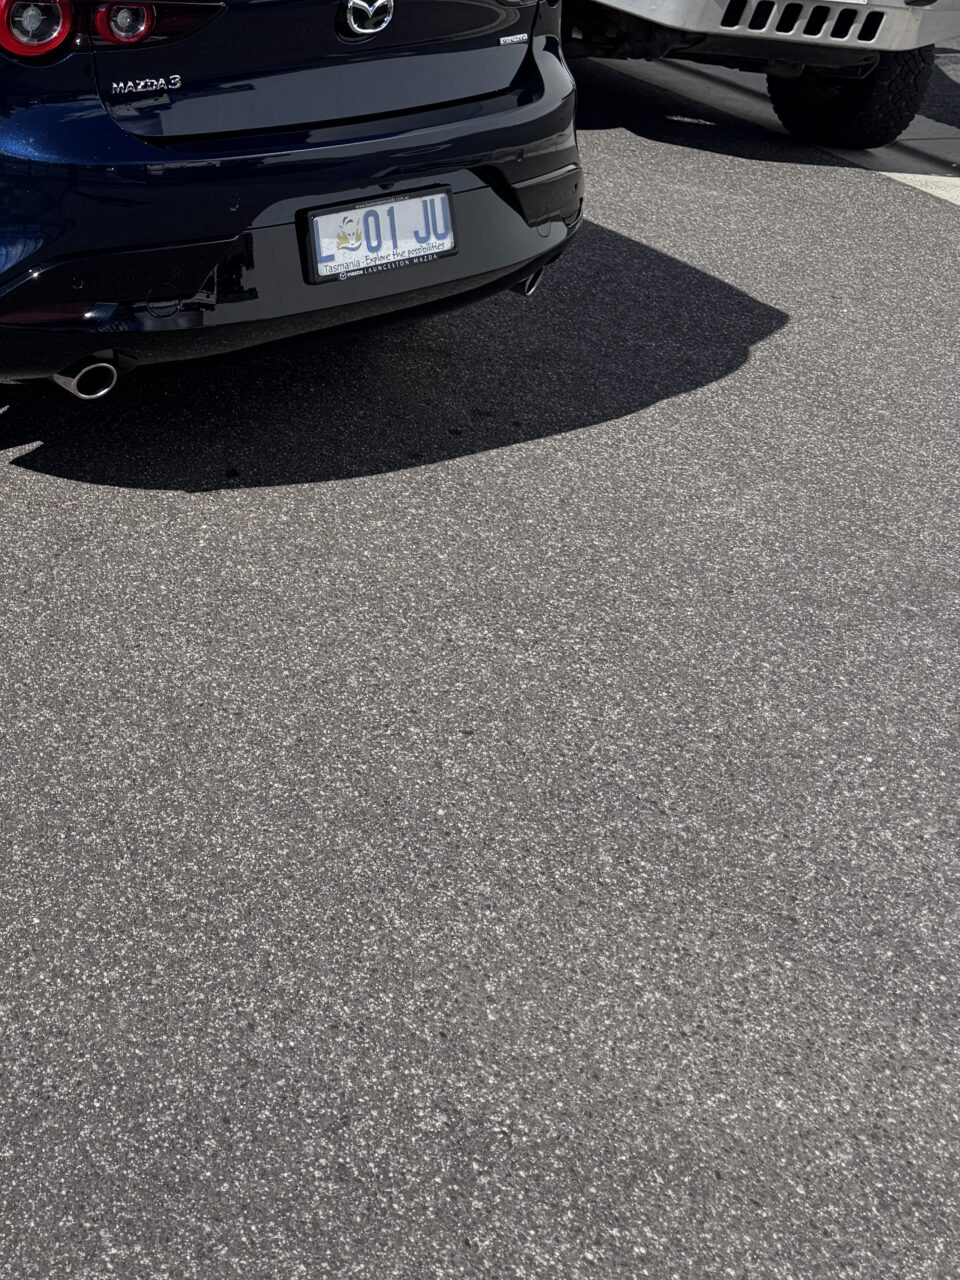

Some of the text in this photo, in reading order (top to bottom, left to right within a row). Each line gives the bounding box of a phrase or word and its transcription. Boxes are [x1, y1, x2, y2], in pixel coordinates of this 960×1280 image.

[314, 197, 450, 263] L 01 JU
[323, 260, 361, 274] Tasmania
[365, 252, 391, 266] Explore
[392, 248, 407, 259] the
[407, 241, 445, 259] possibilities
[364, 260, 410, 275] LAUNCESTON
[413, 253, 438, 264] MAZDA
